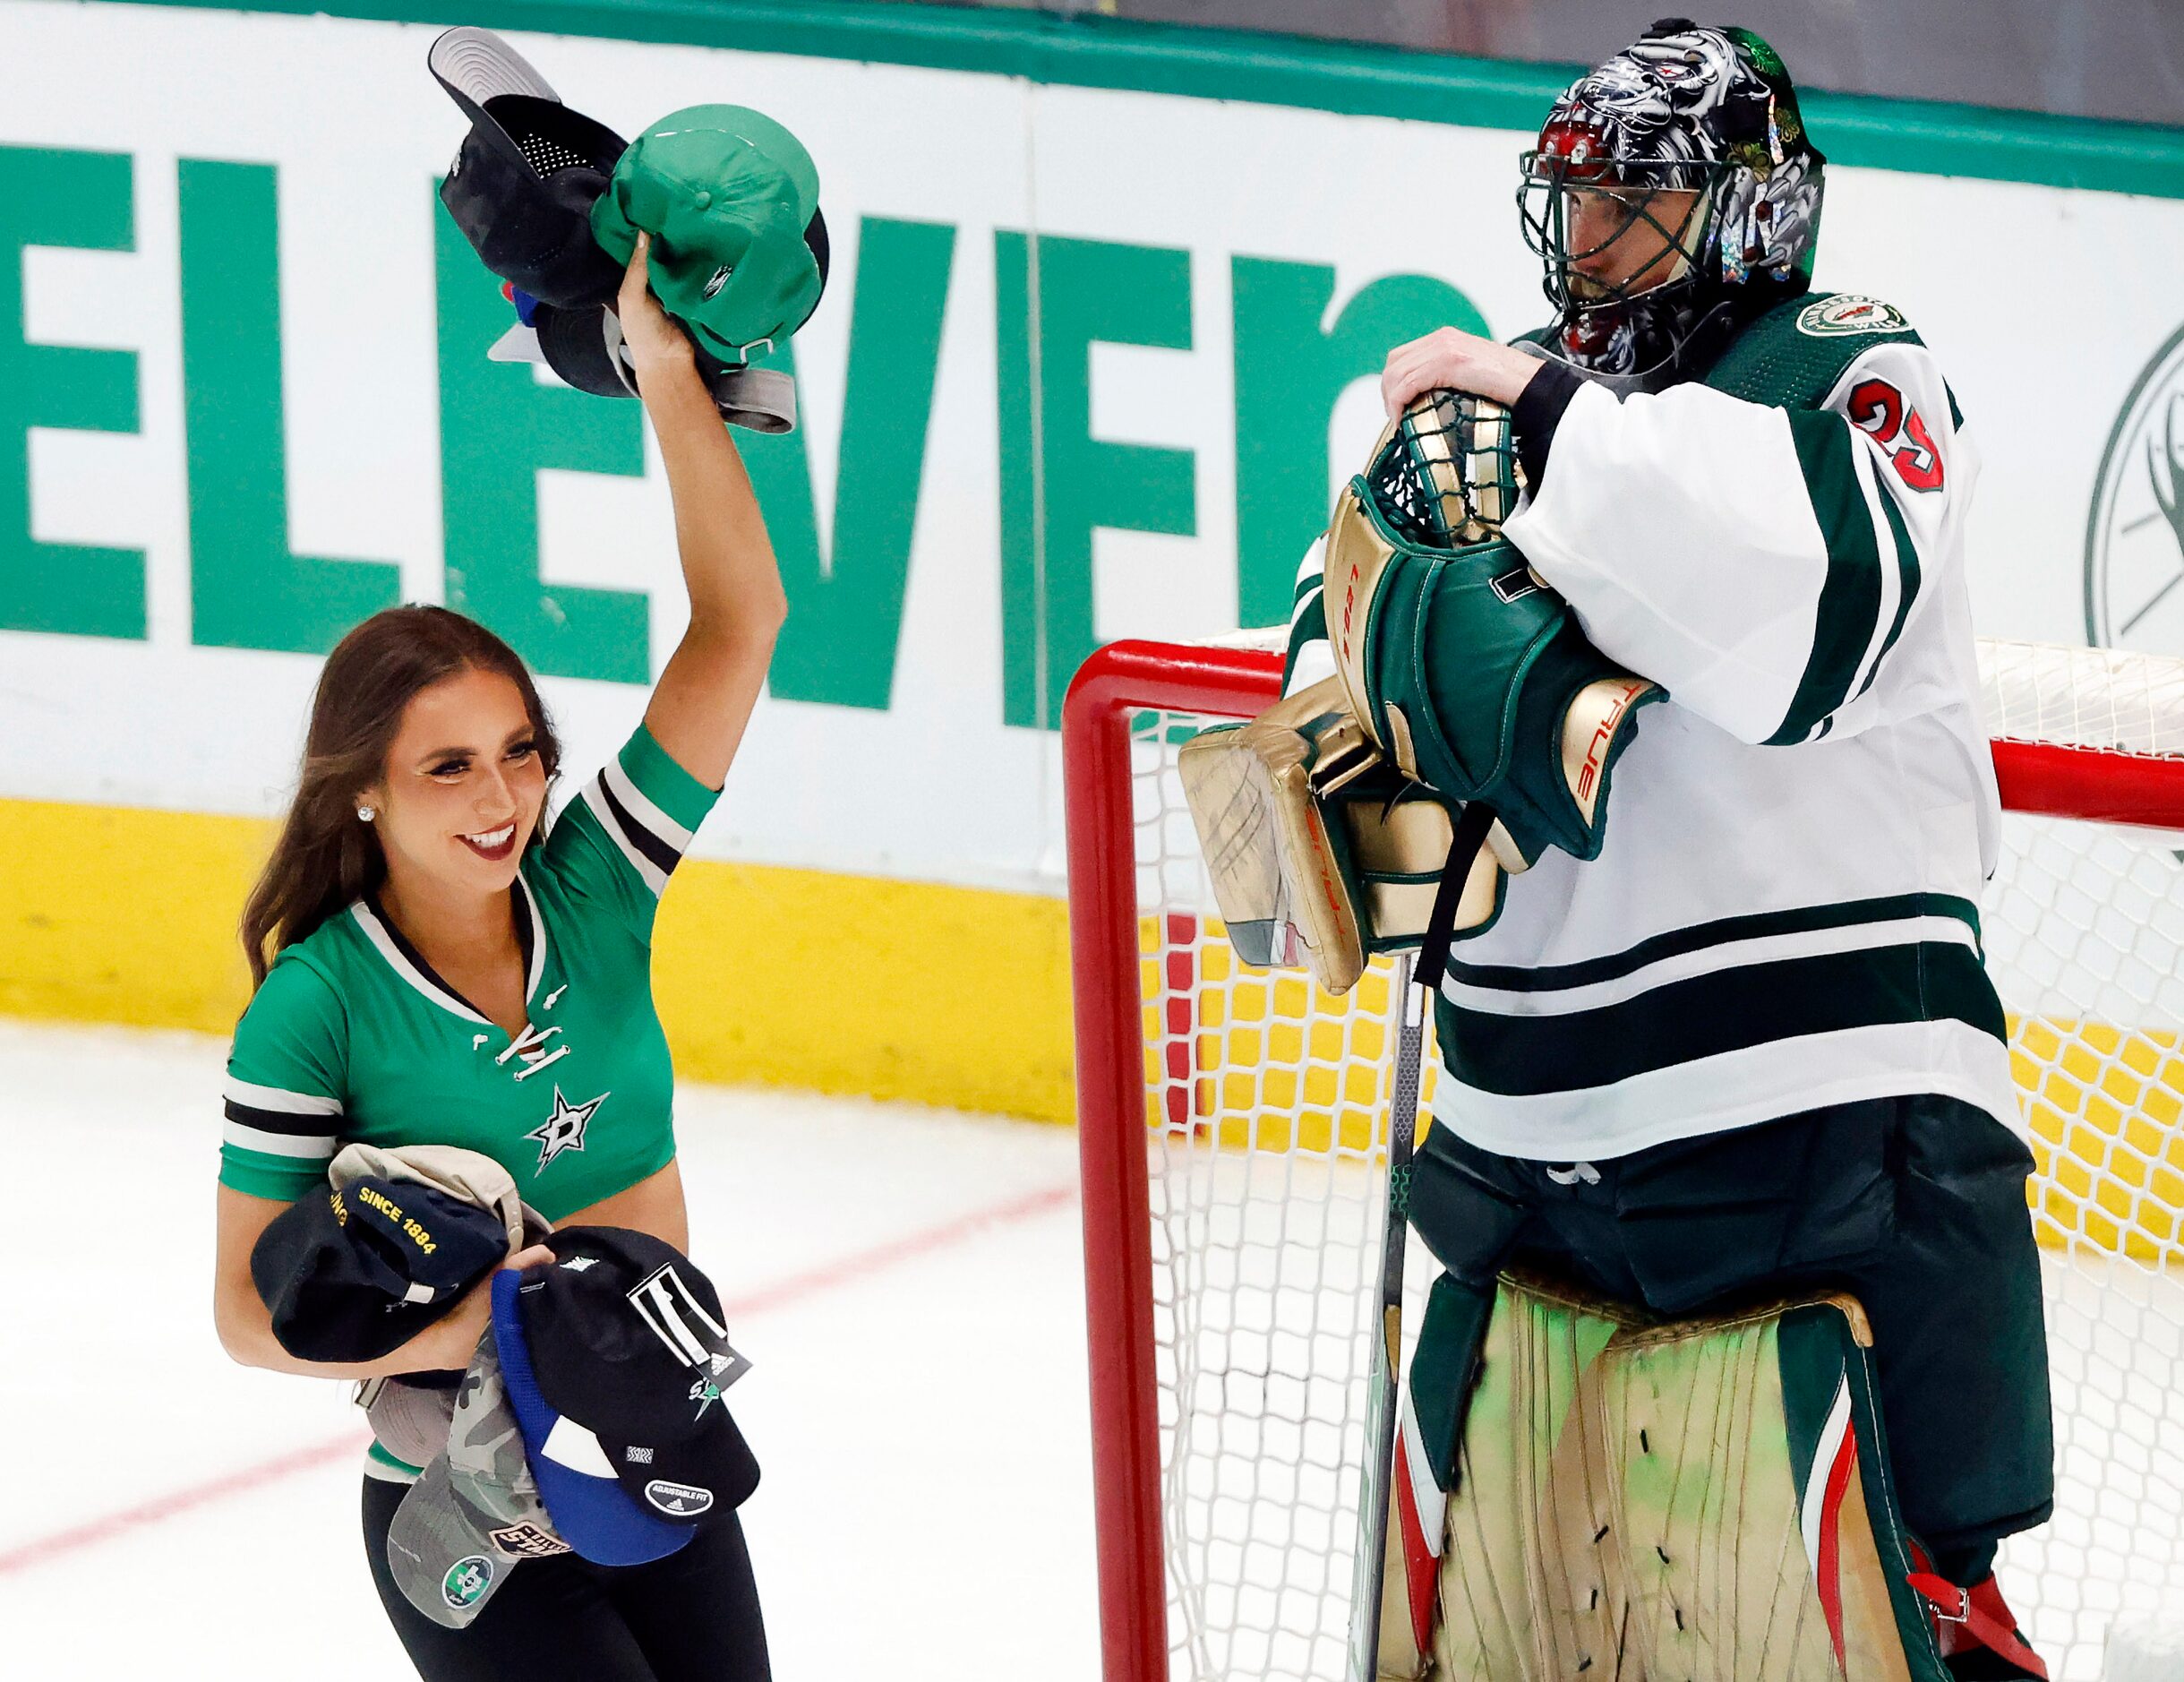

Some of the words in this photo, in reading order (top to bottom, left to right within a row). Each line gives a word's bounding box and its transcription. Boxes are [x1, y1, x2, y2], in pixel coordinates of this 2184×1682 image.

[1577, 683, 1641, 802] TRUE
[358, 1186, 403, 1223] SINCE
[403, 1218, 437, 1255] 1884
[652, 1484, 696, 1499] ADJUSTABLE
[695, 1492, 708, 1502] FIT
